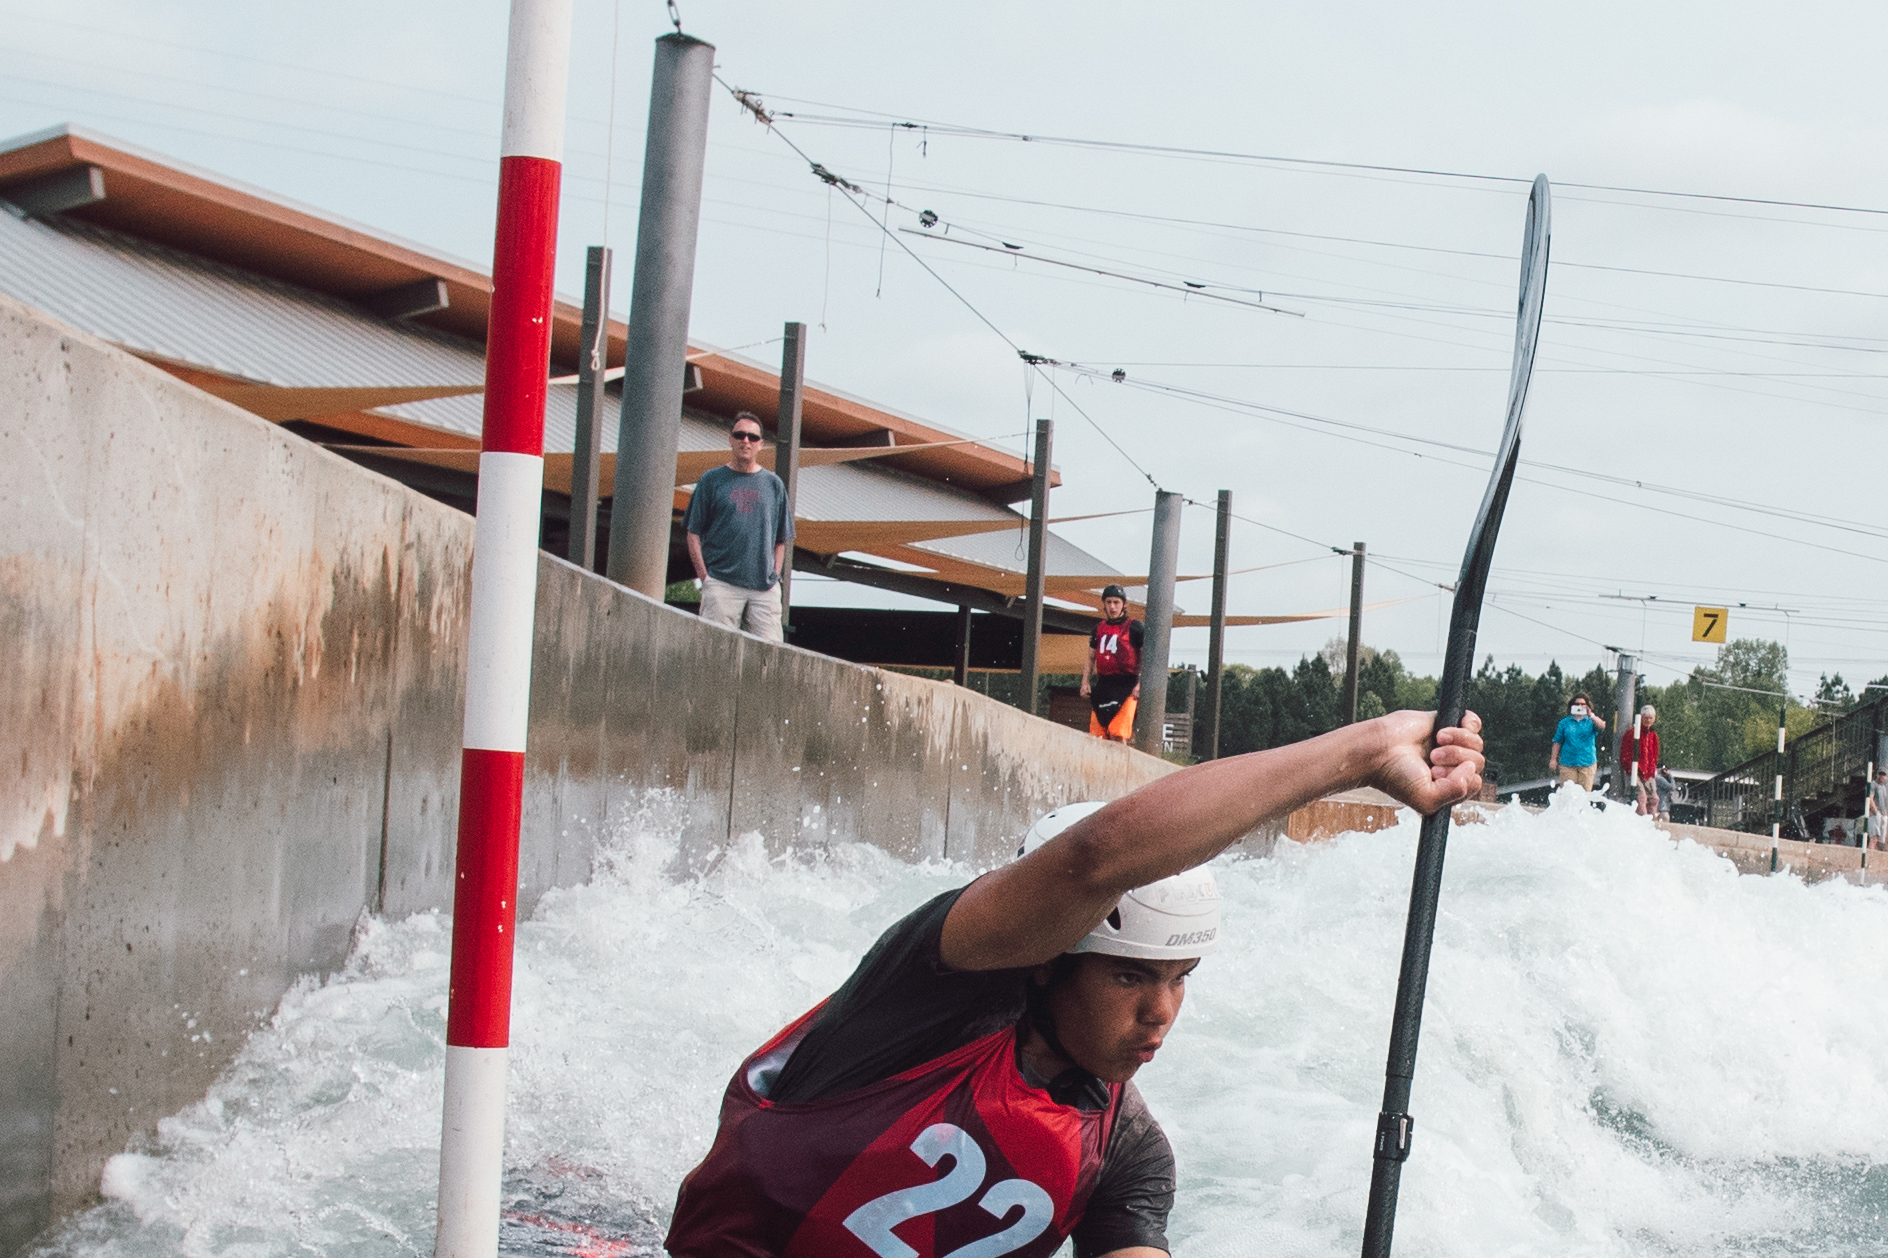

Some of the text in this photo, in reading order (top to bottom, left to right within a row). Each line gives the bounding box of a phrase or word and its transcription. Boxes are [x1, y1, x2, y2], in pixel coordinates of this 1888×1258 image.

[1702, 613, 1719, 637] 7
[1099, 634, 1119, 654] 14
[1164, 928, 1217, 947] DM350
